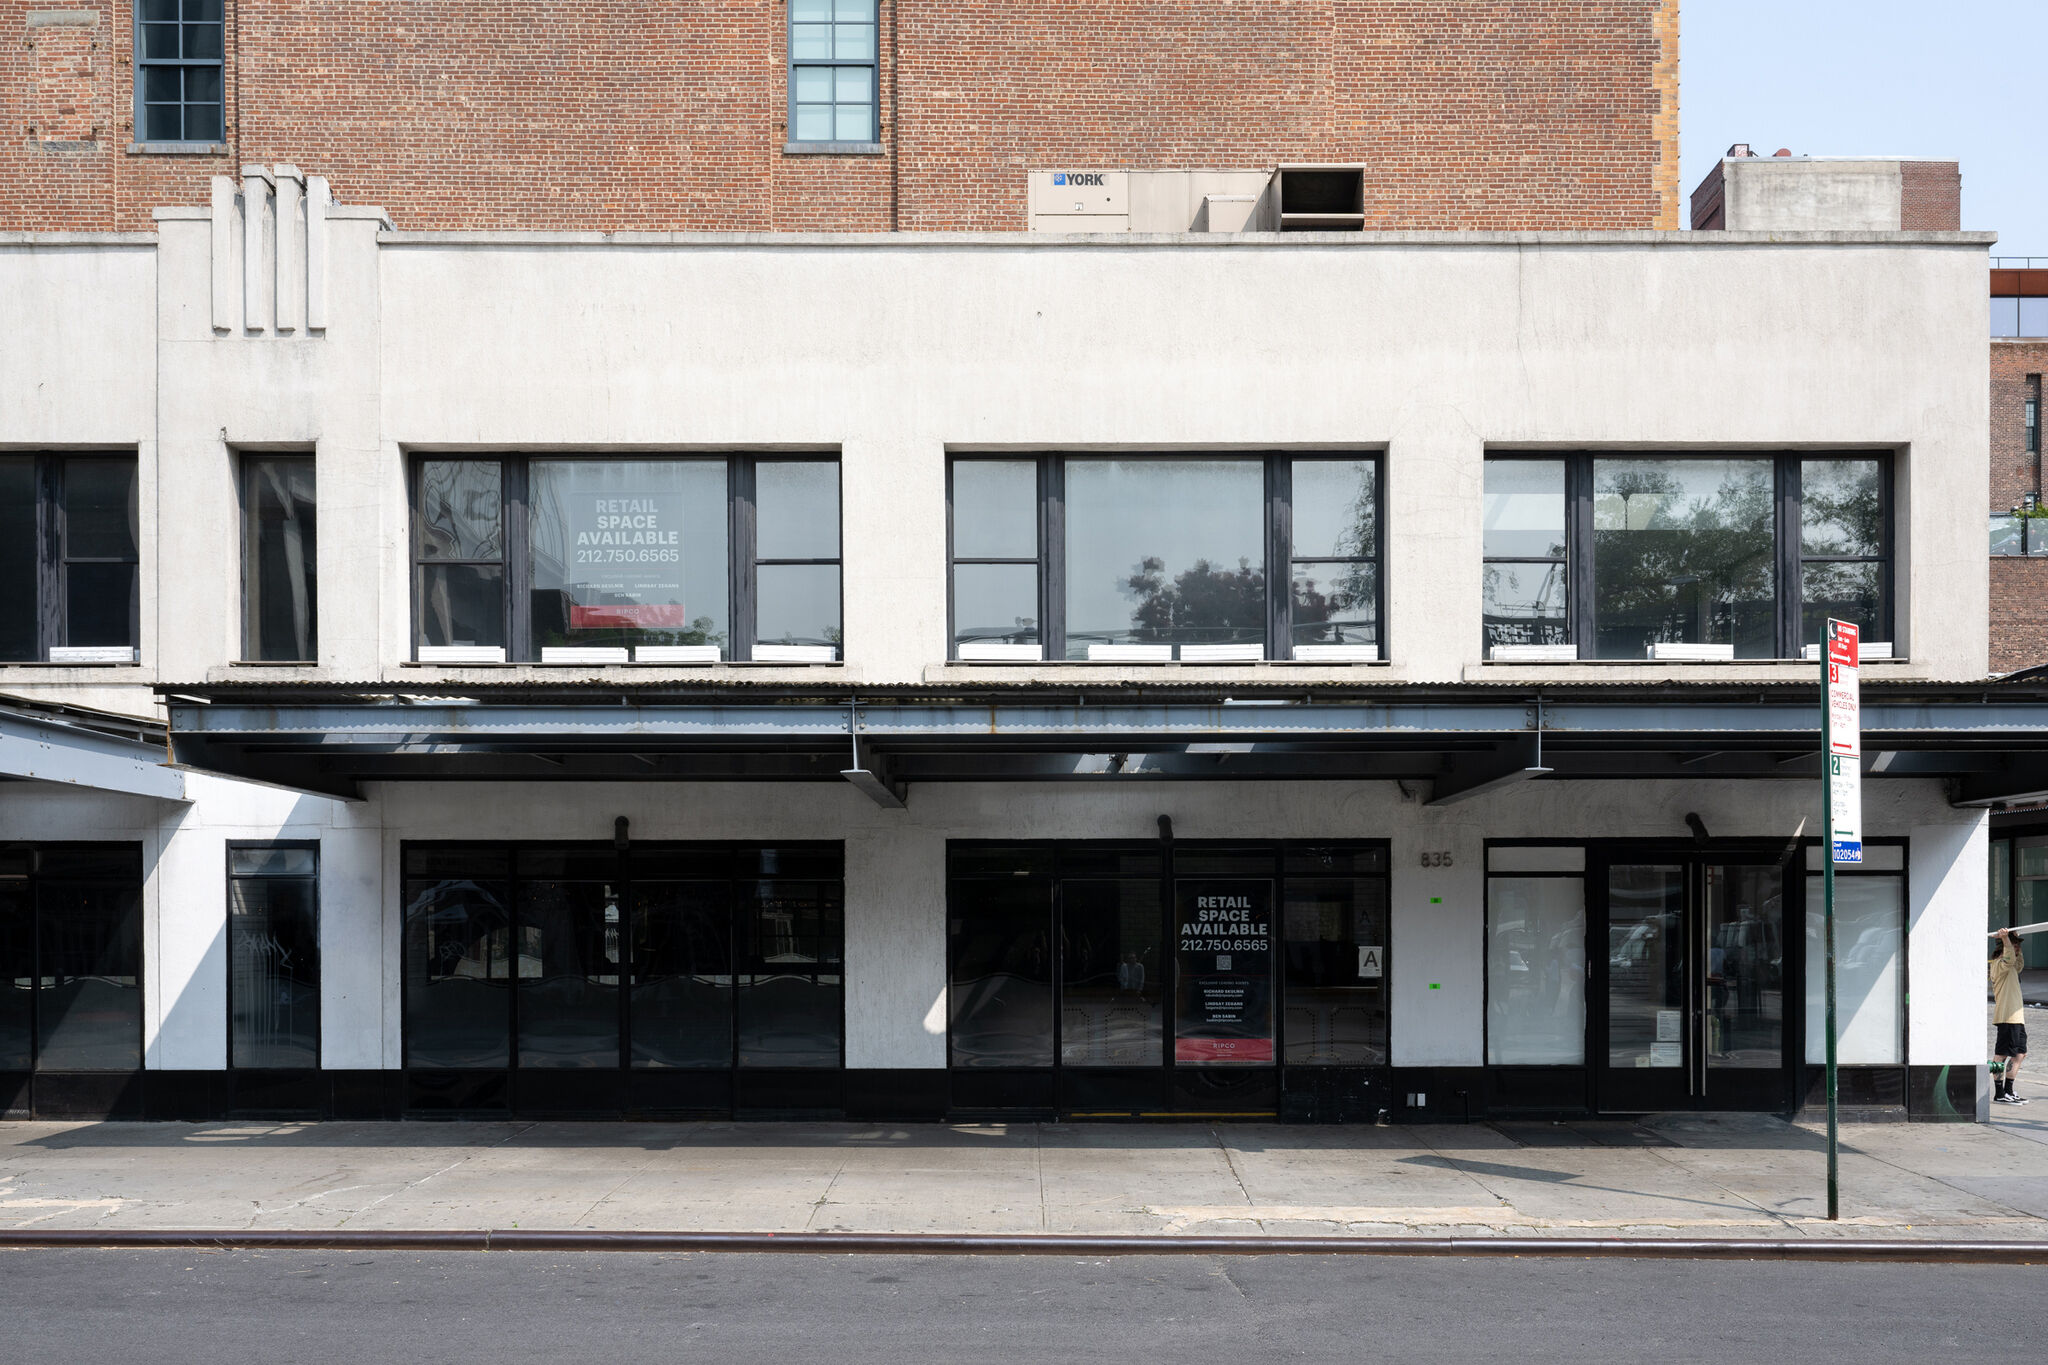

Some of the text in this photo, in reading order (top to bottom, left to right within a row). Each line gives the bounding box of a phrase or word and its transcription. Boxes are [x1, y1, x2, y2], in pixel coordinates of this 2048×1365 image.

[1067, 174, 1104, 186] YORK
[596, 499, 658, 513] RETAIL
[597, 515, 657, 529] SPACE
[577, 531, 679, 545] AVAILABLE
[577, 549, 679, 563] 212.750.6565
[1831, 664, 1837, 682] 3
[1833, 756, 1839, 774] 2
[1421, 852, 1453, 868] 835
[1198, 896, 1251, 908] RETAIL
[1198, 910, 1250, 922] SPACE
[1181, 923, 1268, 935] AVAILABLE
[1181, 939, 1268, 951] 212.750.6565
[1363, 950, 1378, 968] A
